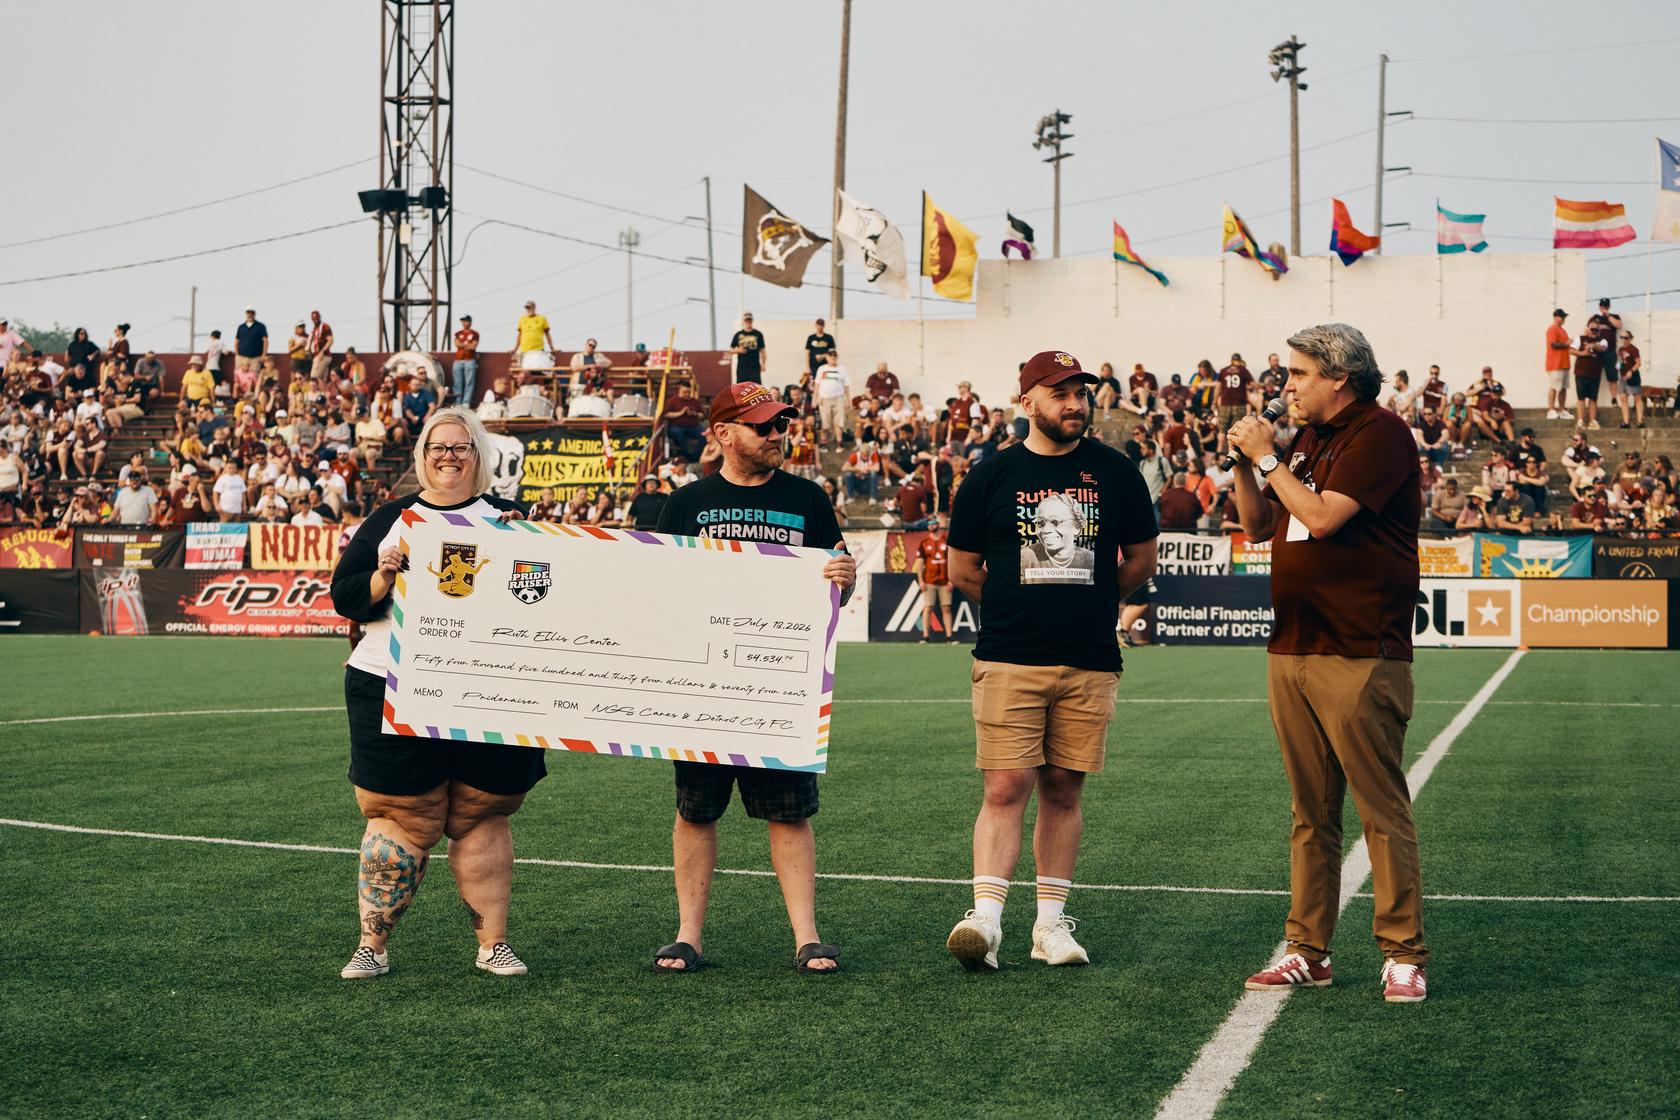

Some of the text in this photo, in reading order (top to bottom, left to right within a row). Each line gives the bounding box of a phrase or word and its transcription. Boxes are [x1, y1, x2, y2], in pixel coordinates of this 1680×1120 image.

[1224, 374, 1240, 388] 19
[749, 394, 770, 406] CITY
[557, 437, 621, 455] AMERICS
[528, 456, 640, 482] MOST HAE
[696, 508, 765, 524] GENDER
[1, 529, 72, 551] REFUGES
[699, 523, 789, 543] AFFIRMING
[261, 524, 345, 567] NORT
[1609, 548, 1644, 558] UNITED
[1648, 548, 1680, 558] FRONT
[509, 579, 551, 589] RAISER
[512, 571, 550, 581] PRIDE
[196, 576, 331, 615] rip it
[1156, 605, 1275, 621] Official Financial
[1412, 589, 1661, 636] SL Championship
[165, 622, 208, 633] OFFICIAL
[209, 623, 247, 633] ENERGY
[247, 624, 278, 634] DRINK
[278, 624, 292, 634] OF
[294, 624, 334, 634] DETROIT
[336, 625, 351, 635] CIT
[420, 616, 465, 628] PAY TO THE
[710, 616, 731, 625] DATE
[733, 617, 769, 632] July
[1156, 622, 1211, 637] Partner
[1213, 623, 1229, 636] of
[1231, 623, 1271, 637] DCFC
[419, 627, 621, 647] ORDER OF Ruth Ellis Center
[722, 649, 729, 659] $
[414, 654, 443, 667] Fifty
[446, 657, 469, 666] four
[471, 659, 516, 671] thousand
[518, 664, 538, 673] five
[541, 666, 586, 677] hundred
[588, 671, 610, 680] and
[611, 672, 638, 685] thirty
[641, 675, 663, 684] four
[666, 677, 705, 688] dollars
[721, 684, 755, 696] seventy
[758, 686, 780, 695] four
[783, 689, 808, 698] cents
[413, 687, 443, 698] MEMO
[461, 691, 540, 705] Prideraiser
[554, 700, 579, 710] FROM
[696, 713, 739, 725] Detroit
[740, 716, 766, 729] City
[769, 719, 794, 730] FC
